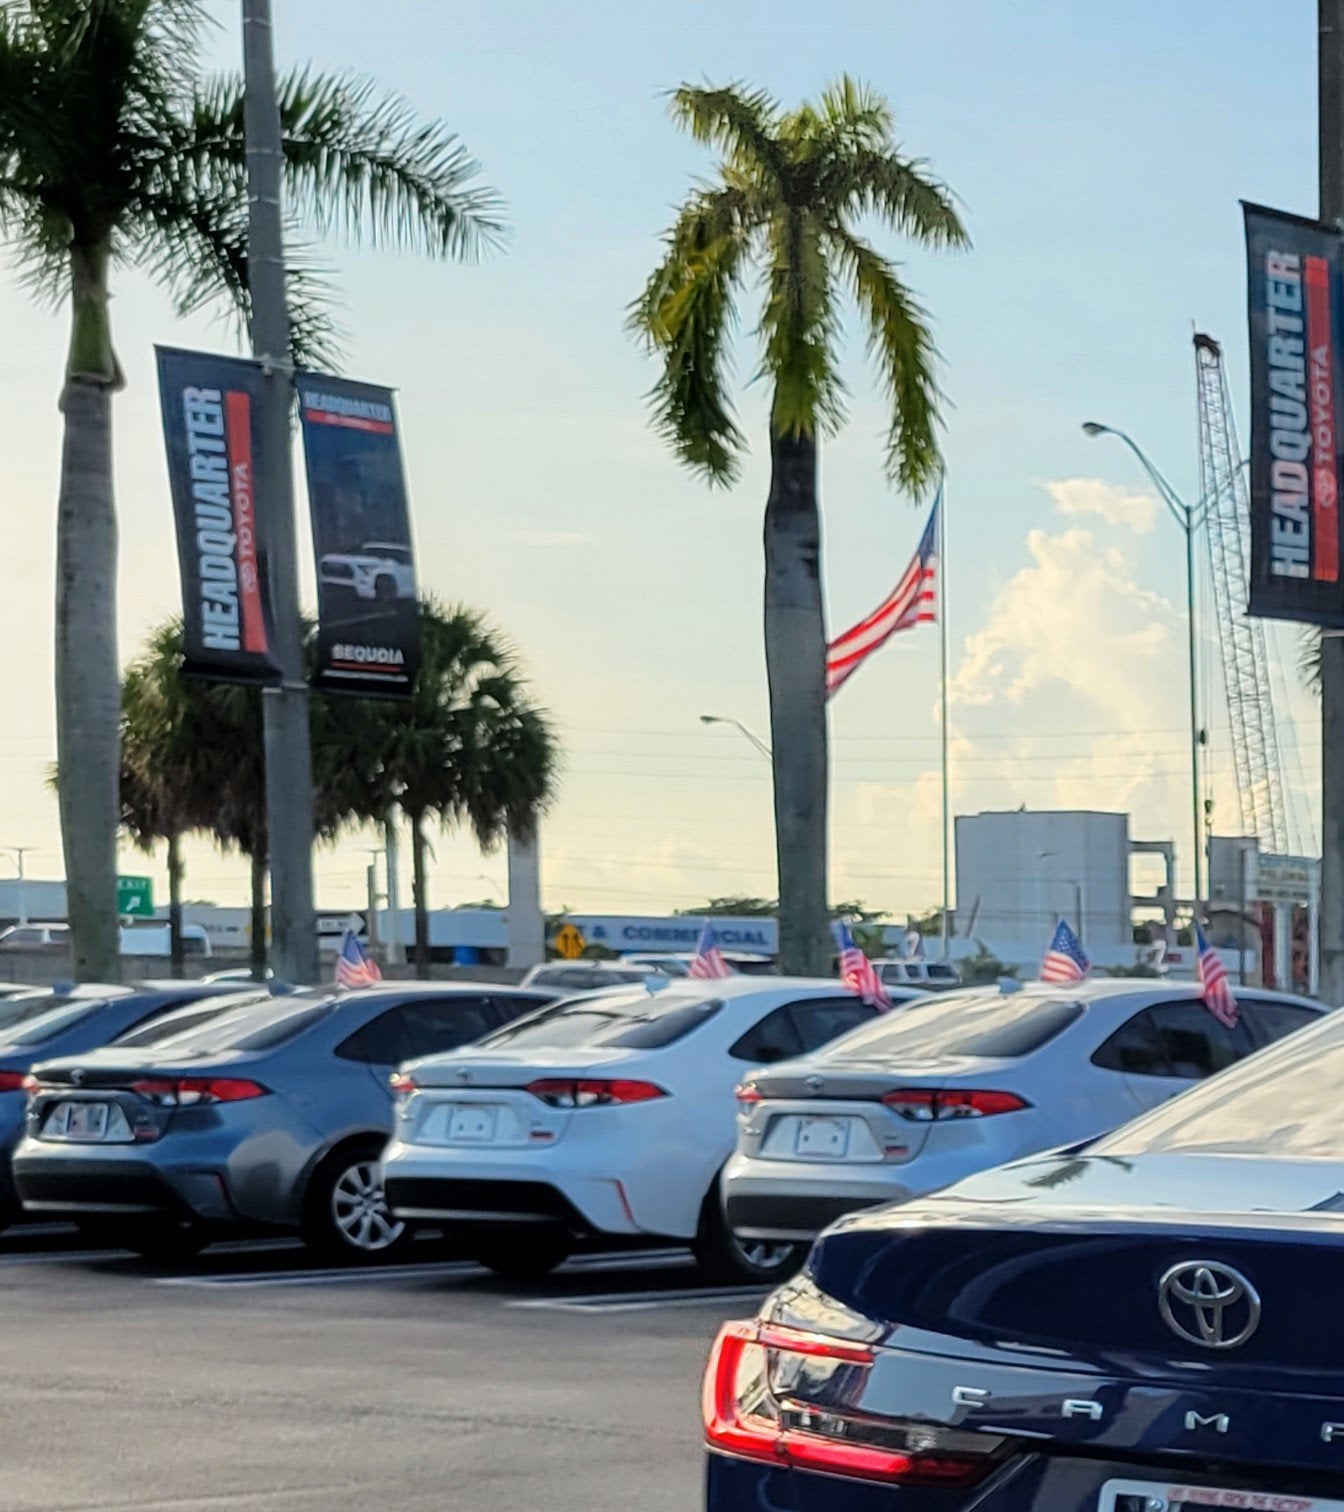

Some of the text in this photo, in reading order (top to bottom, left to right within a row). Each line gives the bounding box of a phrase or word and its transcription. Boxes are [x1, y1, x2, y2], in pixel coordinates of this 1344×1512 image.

[1266, 249, 1314, 580] HEADQUARTER
[1310, 344, 1332, 465] TOYOTA
[182, 385, 240, 651] HEADQUARTER
[234, 463, 255, 557] TOYOTA
[331, 643, 405, 665] SEQUOIA
